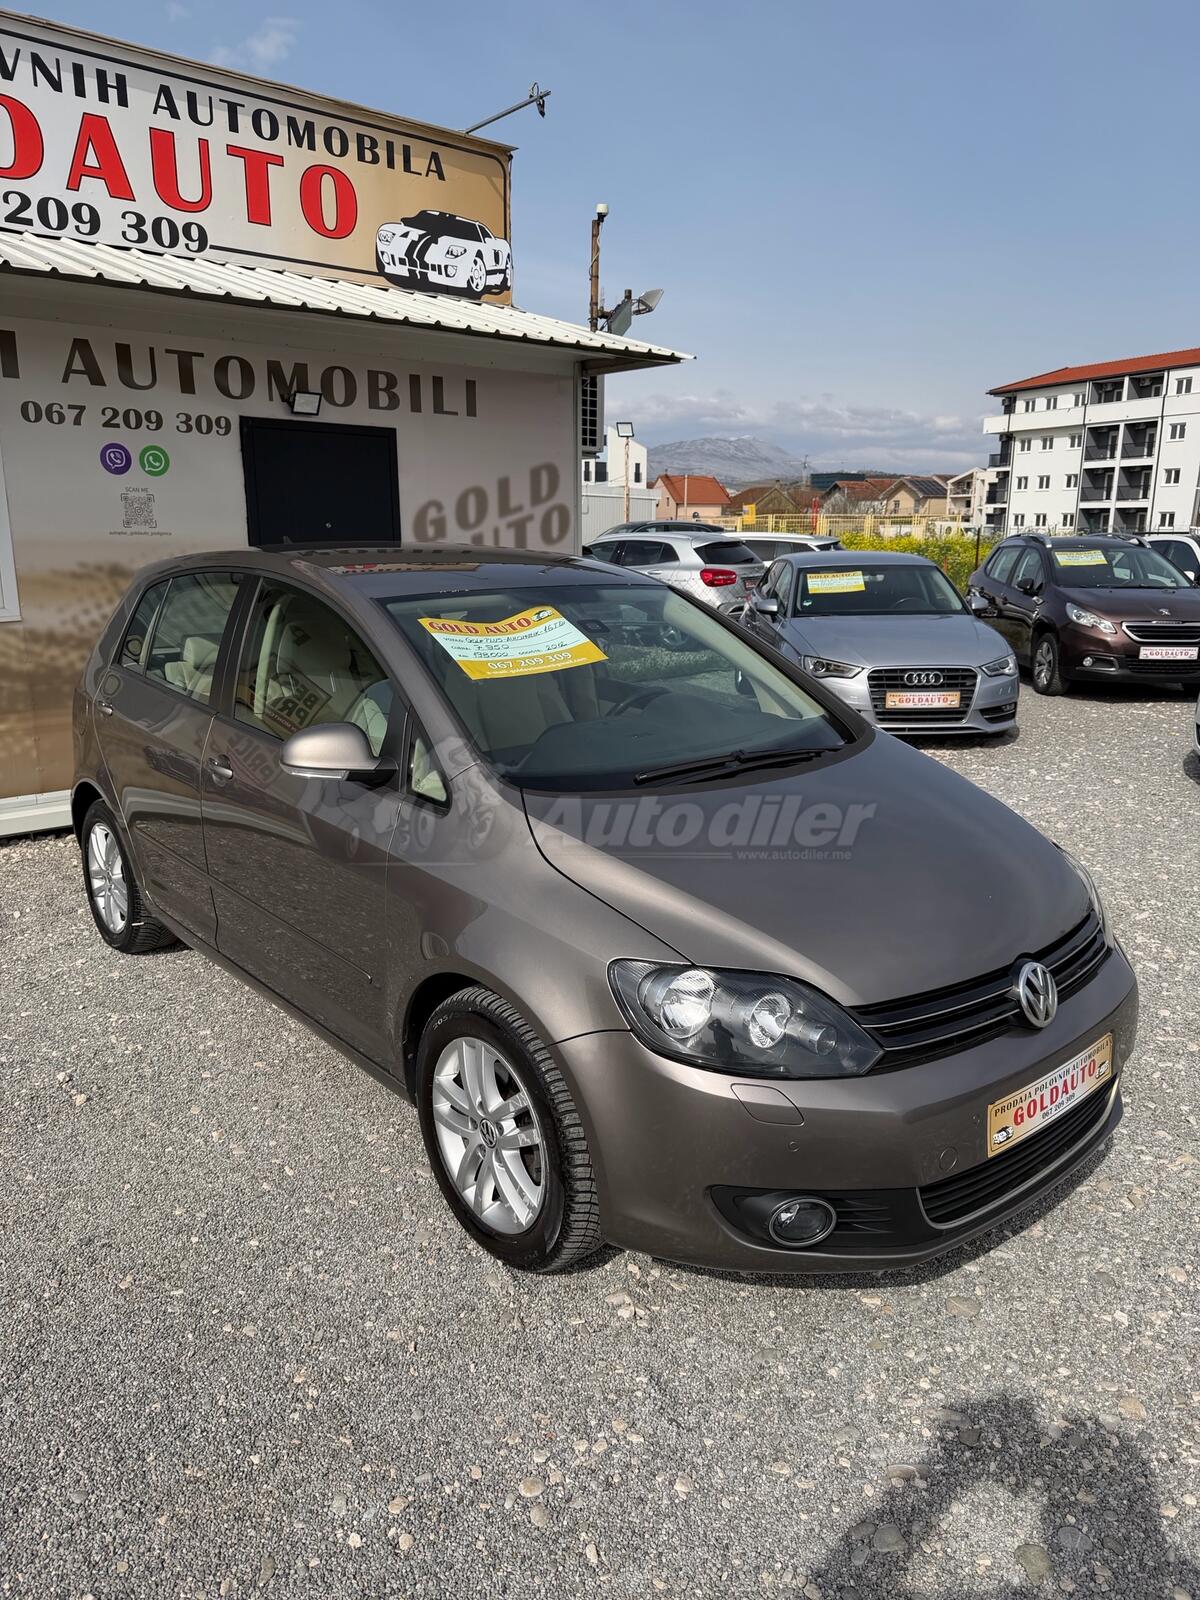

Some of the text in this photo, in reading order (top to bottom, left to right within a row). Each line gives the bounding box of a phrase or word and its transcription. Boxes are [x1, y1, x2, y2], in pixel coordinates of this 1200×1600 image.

[153, 84, 446, 182] AUTOMOBILA
[2, 190, 209, 253] 209 309
[62, 338, 477, 418] AUTOMOBILI
[20, 400, 232, 437] 067 209 309
[413, 462, 560, 543] GOLD
[428, 617, 532, 634] GOLD AUTO
[487, 661, 513, 669] 067
[520, 657, 544, 667] 209
[548, 652, 572, 662] 309
[993, 1039, 1110, 1118] PRODAJA POLOVNIH AUTOMOBILA
[1013, 1058, 1097, 1127] GOLDAUTO
[1041, 1107, 1054, 1120] 067
